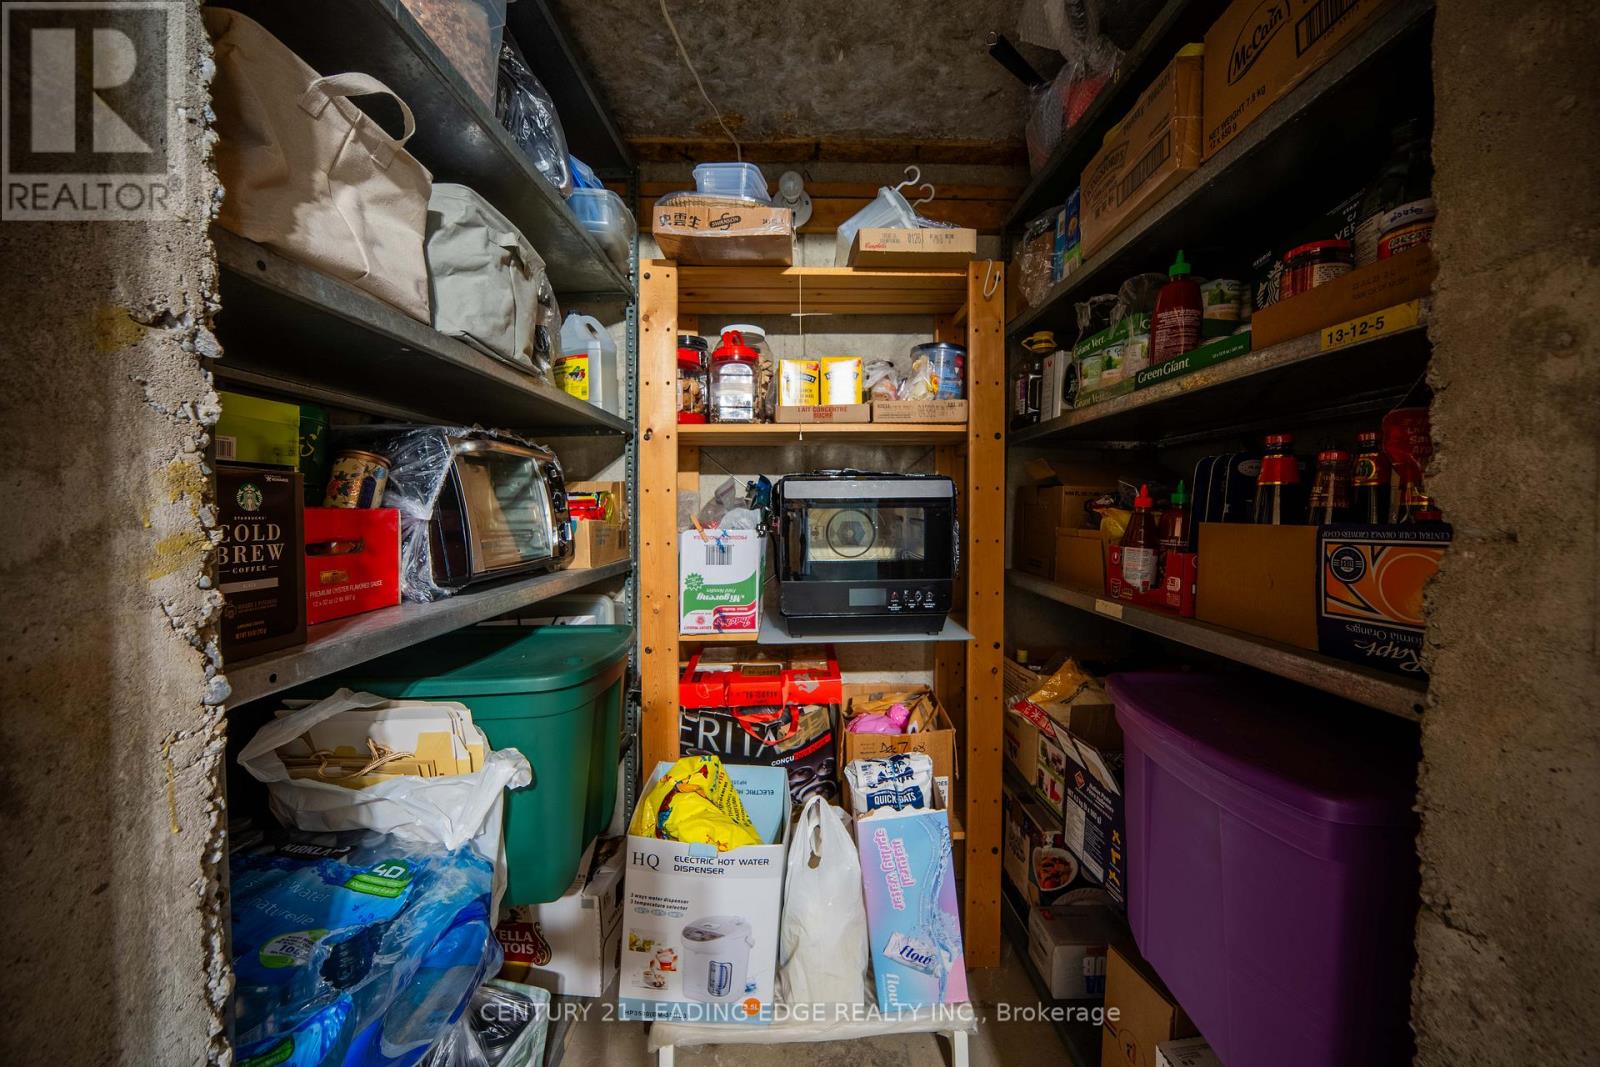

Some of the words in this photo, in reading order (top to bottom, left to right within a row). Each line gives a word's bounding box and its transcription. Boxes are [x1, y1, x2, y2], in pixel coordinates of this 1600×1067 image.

[1233, 6, 1283, 73] McCain
[710, 214, 741, 229] SWANSON
[1327, 316, 1385, 344] 13-12-5
[1369, 530, 1397, 539] ORANGE
[1418, 530, 1451, 541] CENTRAL
[231, 564, 268, 574] COFFEE
[1344, 623, 1387, 640] Oranges
[770, 755, 795, 767] CONÇU
[874, 792, 898, 805] QUICK
[898, 791, 917, 803] OATS
[632, 851, 660, 872] HQ
[673, 855, 714, 865] ELECTRIC
[717, 858, 736, 866] HOT
[738, 858, 770, 866] WATER
[892, 839, 918, 888] natural
[371, 863, 406, 879] 40
[673, 865, 725, 875] DISPENSER
[874, 827, 896, 872] spring
[886, 870, 906, 911] water
[634, 899, 666, 909] temperature
[666, 903, 689, 911] selector
[663, 897, 690, 905] dispenser
[899, 944, 934, 966] flow
